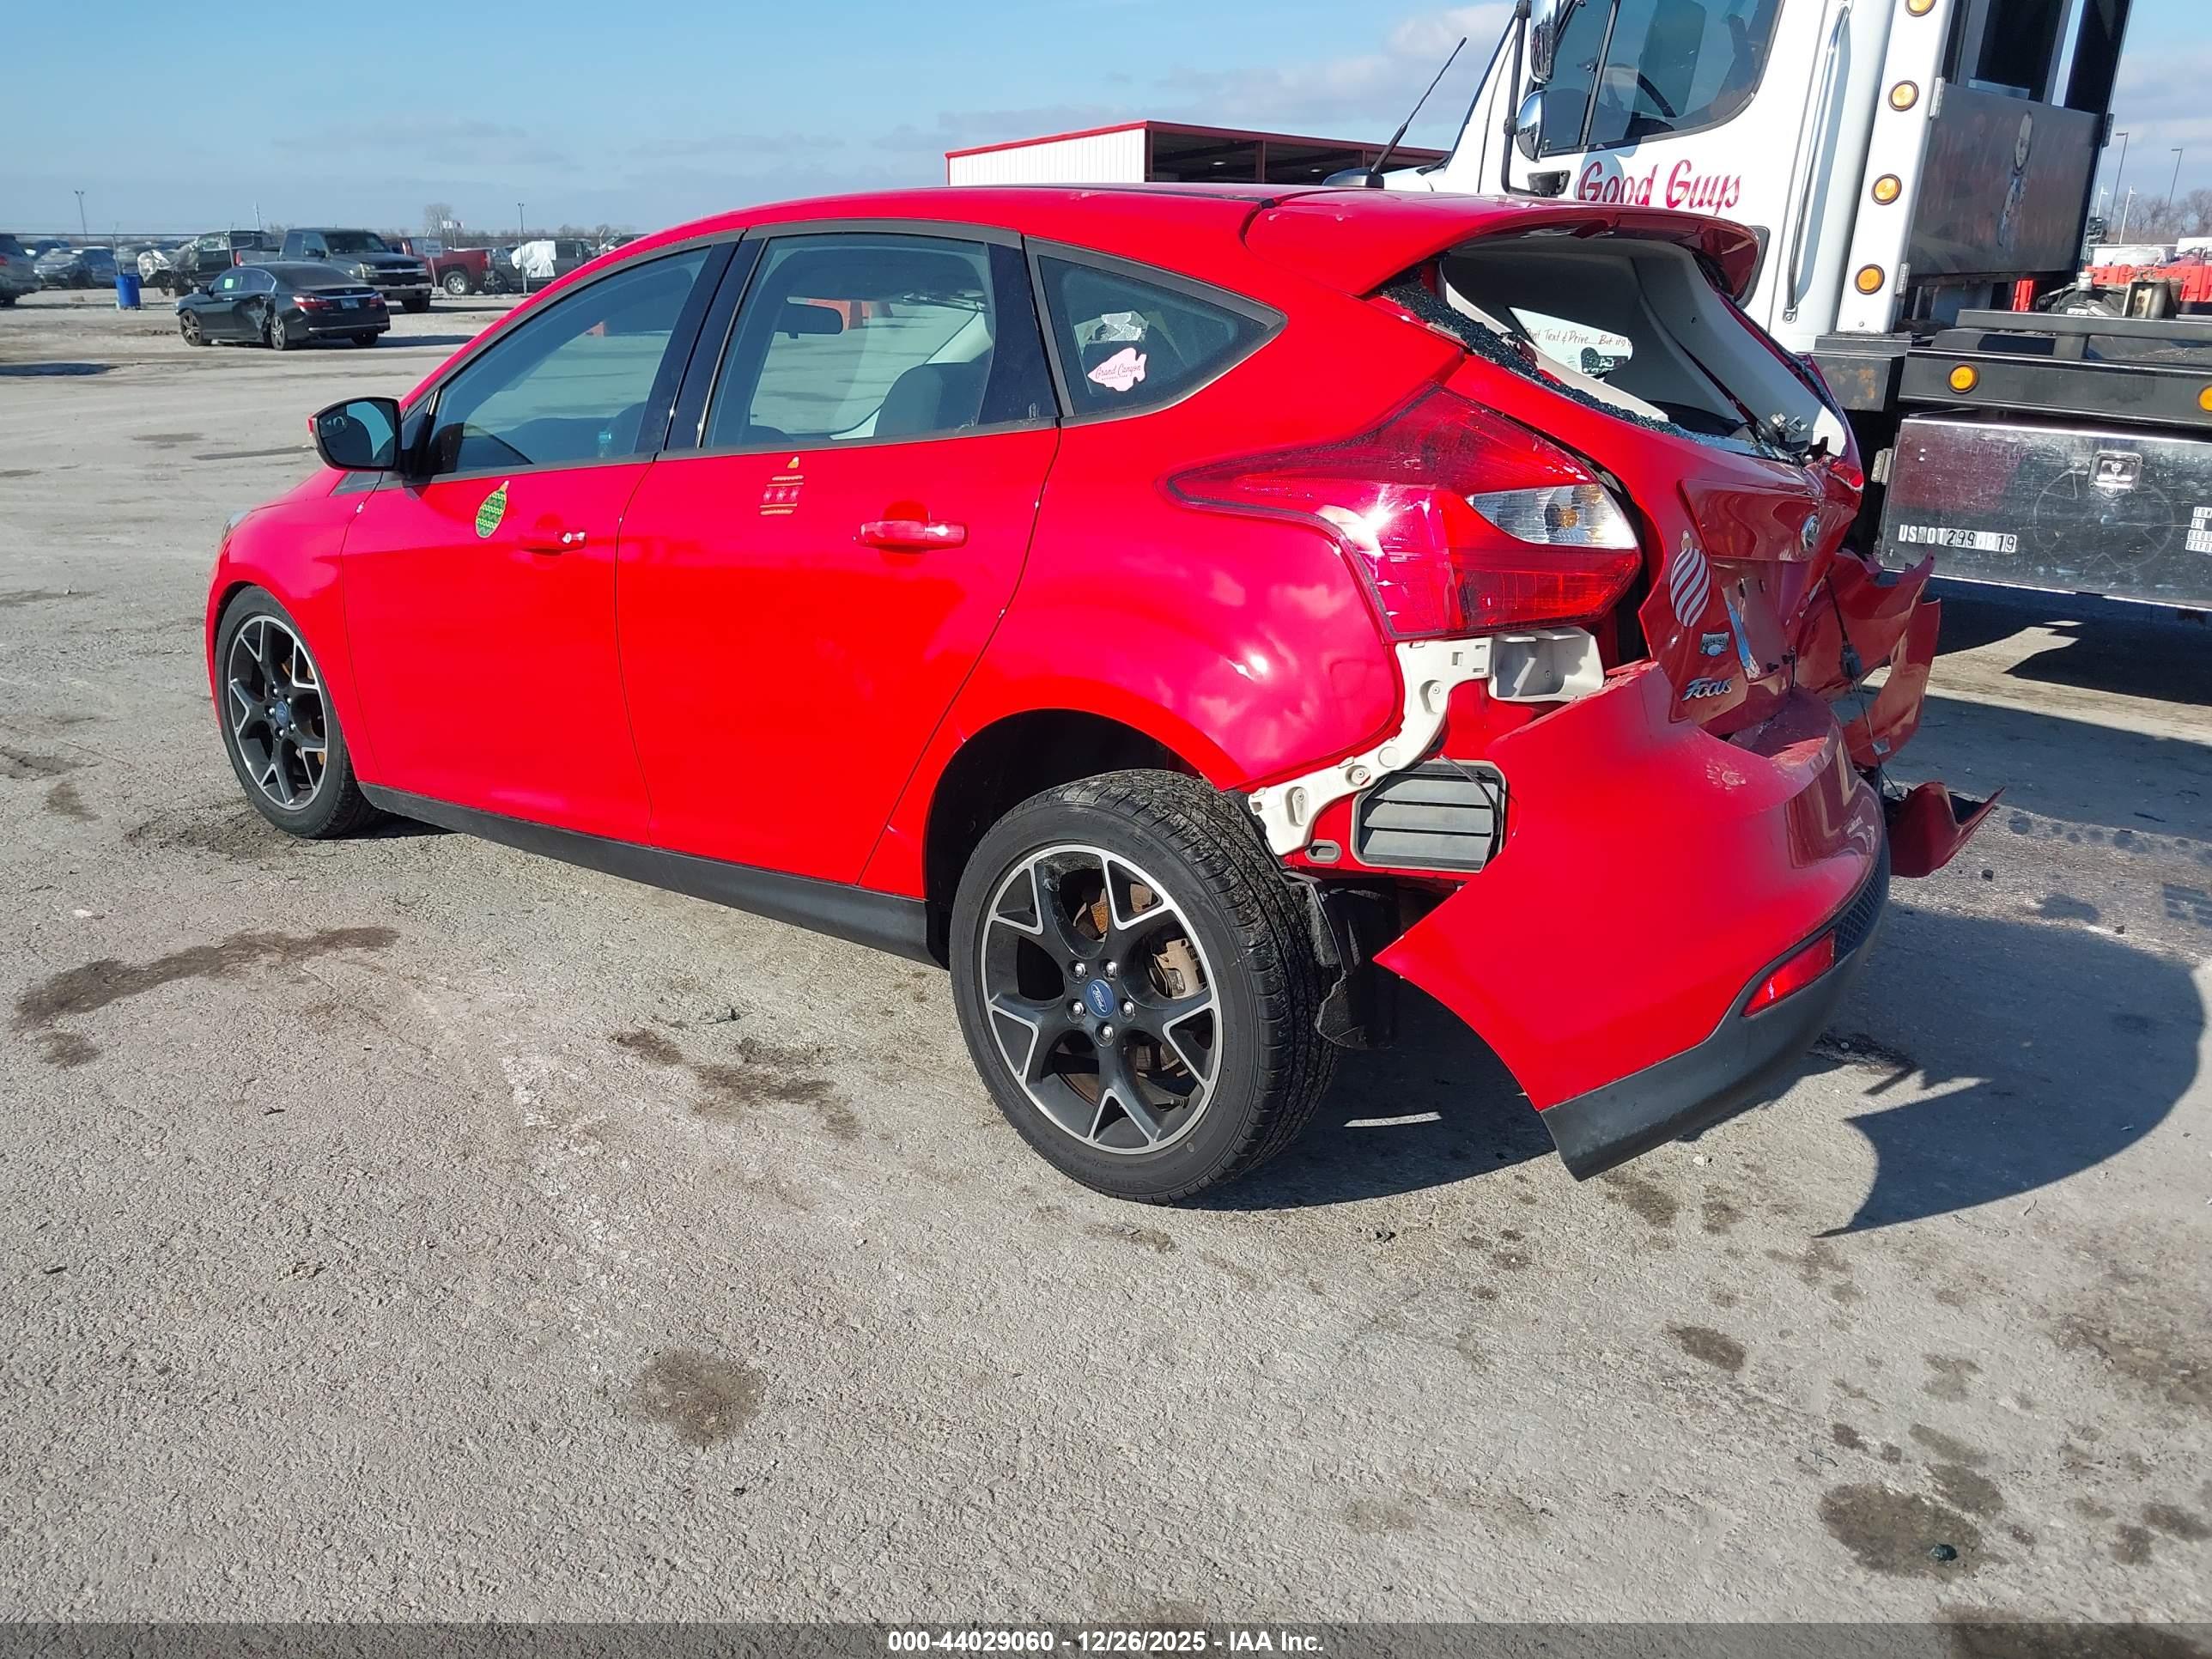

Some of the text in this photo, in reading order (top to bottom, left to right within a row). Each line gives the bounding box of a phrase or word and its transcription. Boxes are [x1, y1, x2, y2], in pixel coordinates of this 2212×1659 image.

[1577, 159, 1741, 216] Good Guys
[1096, 364, 1117, 379] Grand
[1118, 362, 1141, 377] Canyon
[2186, 541, 2212, 551] BEFO
[1681, 677, 1732, 701] Focus
